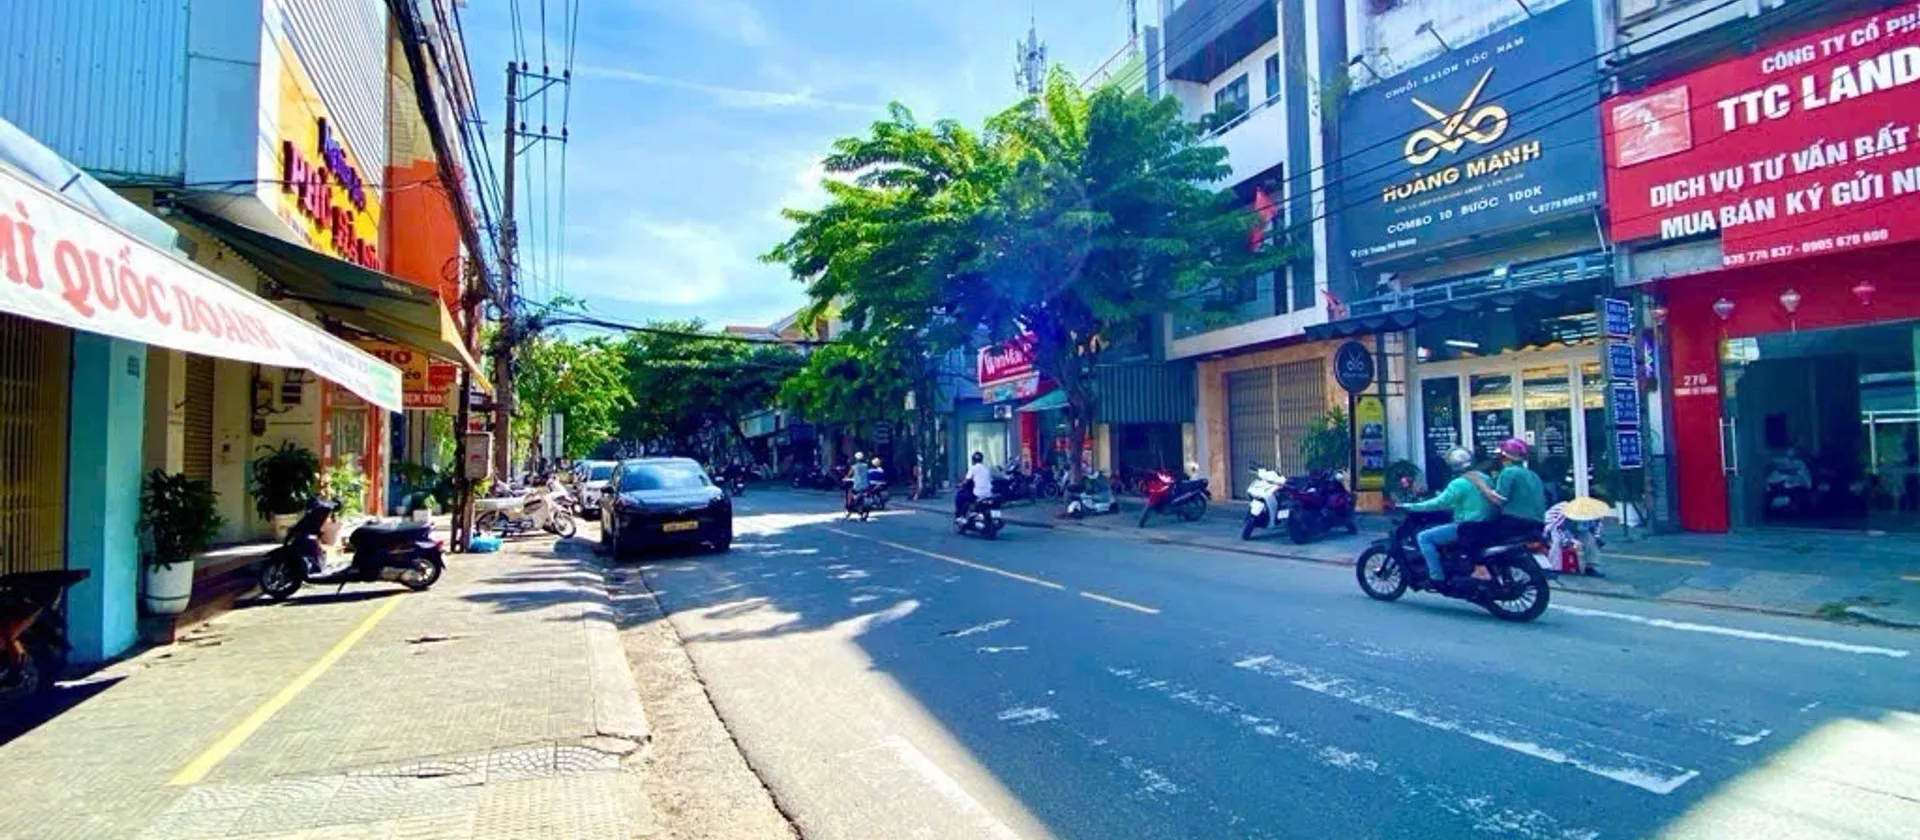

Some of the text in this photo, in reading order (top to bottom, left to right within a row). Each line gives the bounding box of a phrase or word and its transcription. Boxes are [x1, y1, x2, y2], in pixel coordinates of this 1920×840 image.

[1497, 37, 1524, 54] NAM
[1762, 44, 1815, 74] CÔNG
[1820, 34, 1846, 56] TY
[1850, 17, 1880, 47] CỔ
[1717, 46, 1920, 131] TTC LAND
[1382, 167, 1460, 202] HOÀNG
[1466, 141, 1541, 177] MẠNH
[1650, 175, 1705, 208] DỊCH
[1710, 165, 1745, 190] VỤ
[1749, 153, 1786, 184] TƯ
[1792, 138, 1848, 174] VẤN
[1387, 215, 1432, 234] COMBO
[1439, 209, 1453, 221] 10
[1509, 186, 1543, 202] 100K
[1661, 209, 1718, 240] MUA
[1721, 196, 1775, 229] BÁN
[1785, 182, 1824, 215] KÝ
[1831, 170, 1884, 207] GỬI
[54, 240, 172, 325] QUỐC
[171, 284, 281, 351] DOANH
